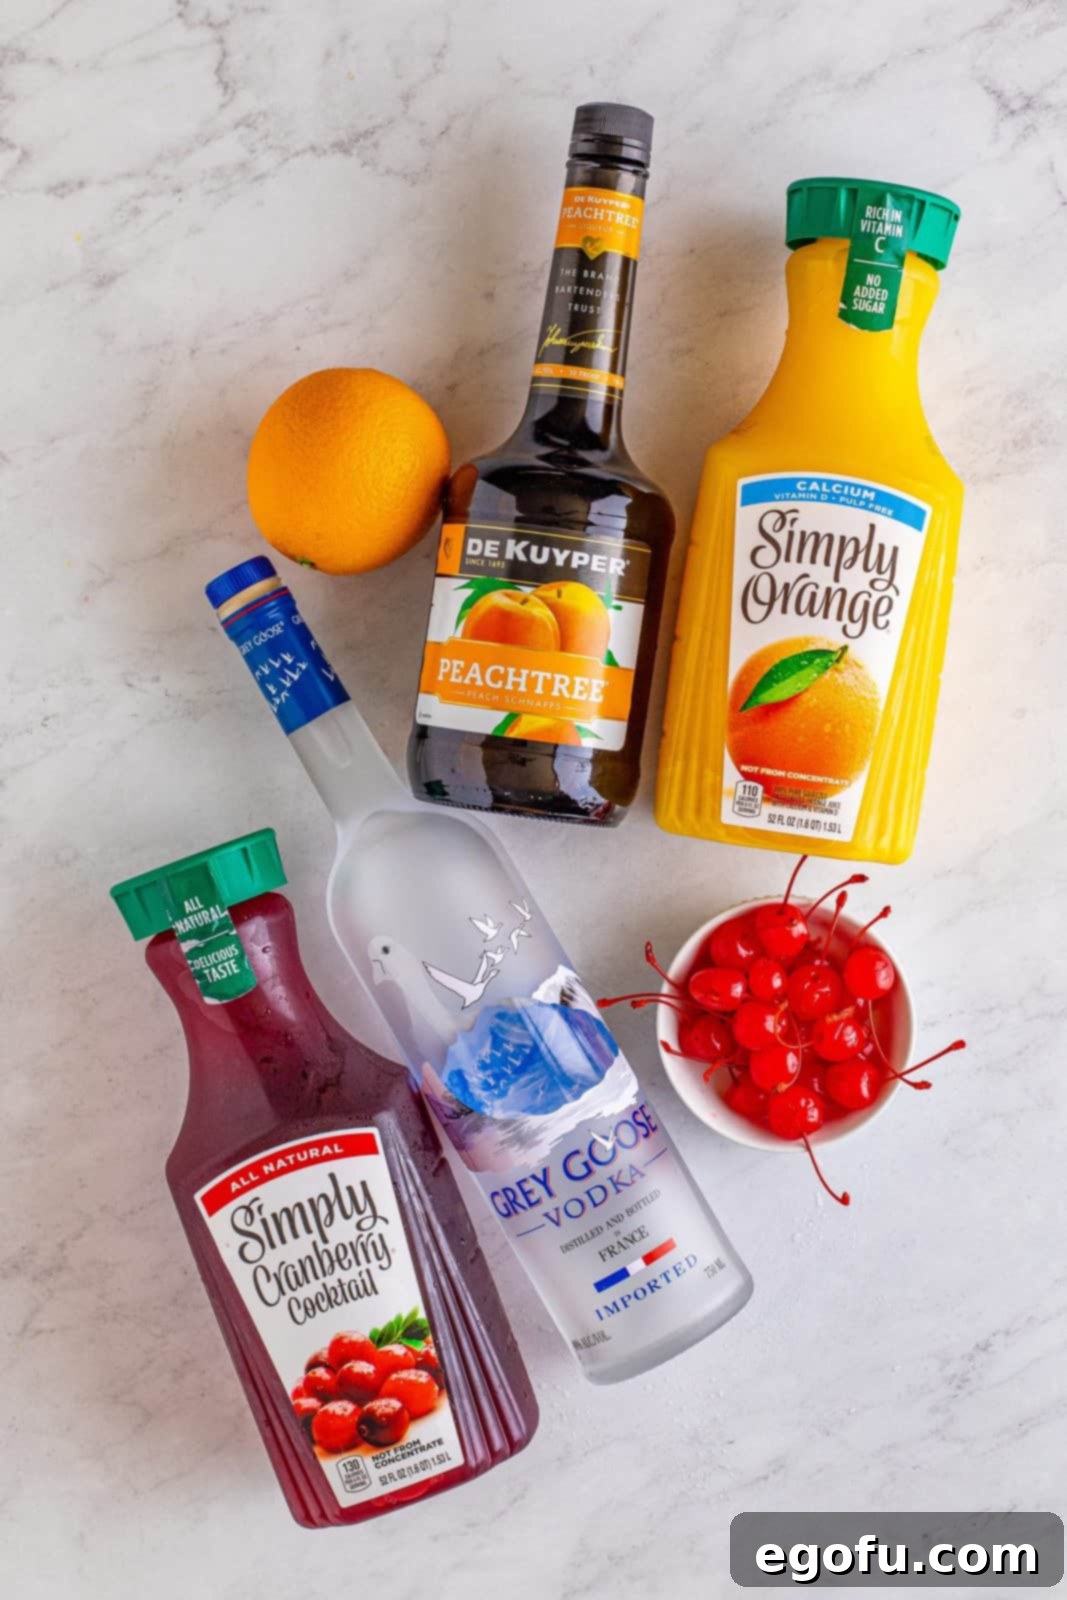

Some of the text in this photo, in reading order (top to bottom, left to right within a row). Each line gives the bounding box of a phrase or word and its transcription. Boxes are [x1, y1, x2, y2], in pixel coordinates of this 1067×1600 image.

[574, 195, 585, 203] DE
[561, 206, 640, 229] PEACHTREE
[865, 205, 902, 222] RICH IN
[860, 219, 903, 237] VITAMIN
[874, 236, 886, 253] C
[560, 268, 577, 277] THE
[866, 273, 881, 286] NO
[853, 285, 888, 300] ADDED
[567, 302, 601, 314] TRUST
[852, 298, 885, 314] SUGAR
[796, 480, 876, 501] CALCIUM
[774, 492, 895, 516] VITAMIN D PULP FREE
[465, 557, 485, 567] SINCE
[466, 537, 626, 576] DE KUYPER
[750, 508, 900, 596] Simply
[740, 571, 894, 640] Orange
[437, 657, 605, 703] PEACHTREE
[466, 690, 562, 709] PEACH SCHNAPPS
[740, 764, 850, 786] NOT FROM CONCENTRATE
[742, 784, 758, 797] 110
[768, 813, 777, 824] 52
[786, 816, 796, 827] OZ
[184, 895, 204, 914] ALL
[173, 904, 228, 933] NATURAL
[193, 944, 239, 970] DELICIOUS
[203, 959, 240, 984] TASTE
[229, 1142, 345, 1193] ALL NATURAL
[490, 1104, 659, 1219] GREY GOOSE
[542, 1163, 647, 1228] VODKA
[231, 1172, 390, 1265] Simply
[560, 1188, 662, 1254] DISTILLED AND BOTTLED
[597, 1224, 650, 1263] FRANCE
[252, 1232, 393, 1308] Cranberry
[286, 1267, 380, 1326] Cocktail
[595, 1253, 699, 1322] IMPORTED
[371, 1438, 421, 1462] NOT FROM
[374, 1437, 444, 1470] CONCENTRATE
[342, 1459, 360, 1472] 130
